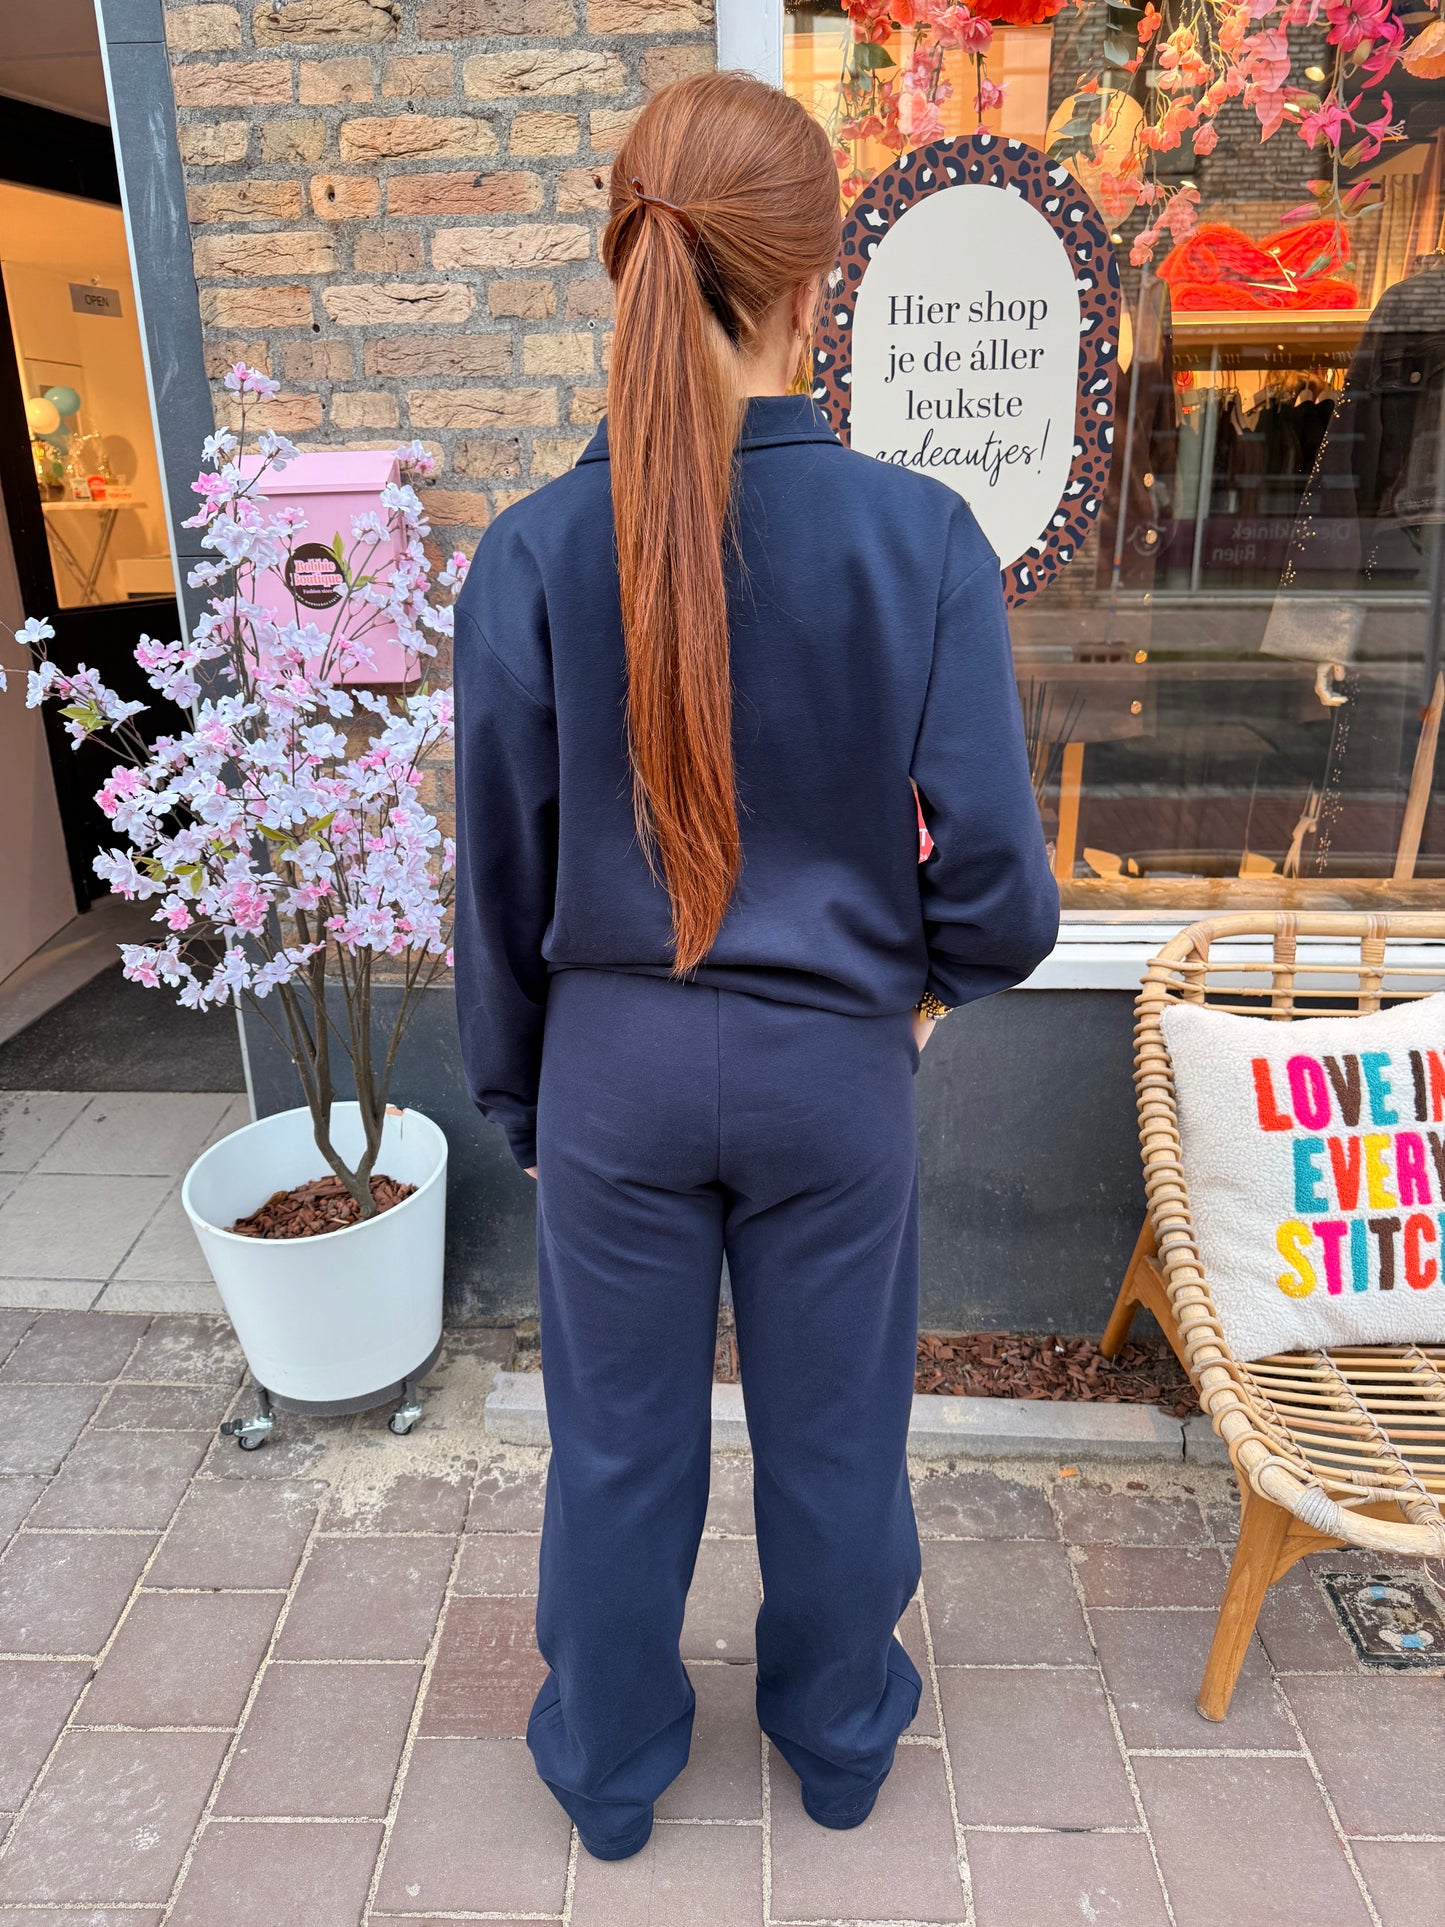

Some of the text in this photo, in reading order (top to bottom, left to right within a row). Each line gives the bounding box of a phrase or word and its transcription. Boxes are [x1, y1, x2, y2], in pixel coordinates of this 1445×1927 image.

[85, 294, 109, 307] OPEN
[887, 290, 1048, 330] Hier shop
[884, 339, 1044, 383] je de áller
[905, 388, 1023, 420] leukste
[294, 558, 336, 573] Bobbie
[1251, 1051, 1398, 1132] LOVE
[1275, 1213, 1445, 1299] STITC
